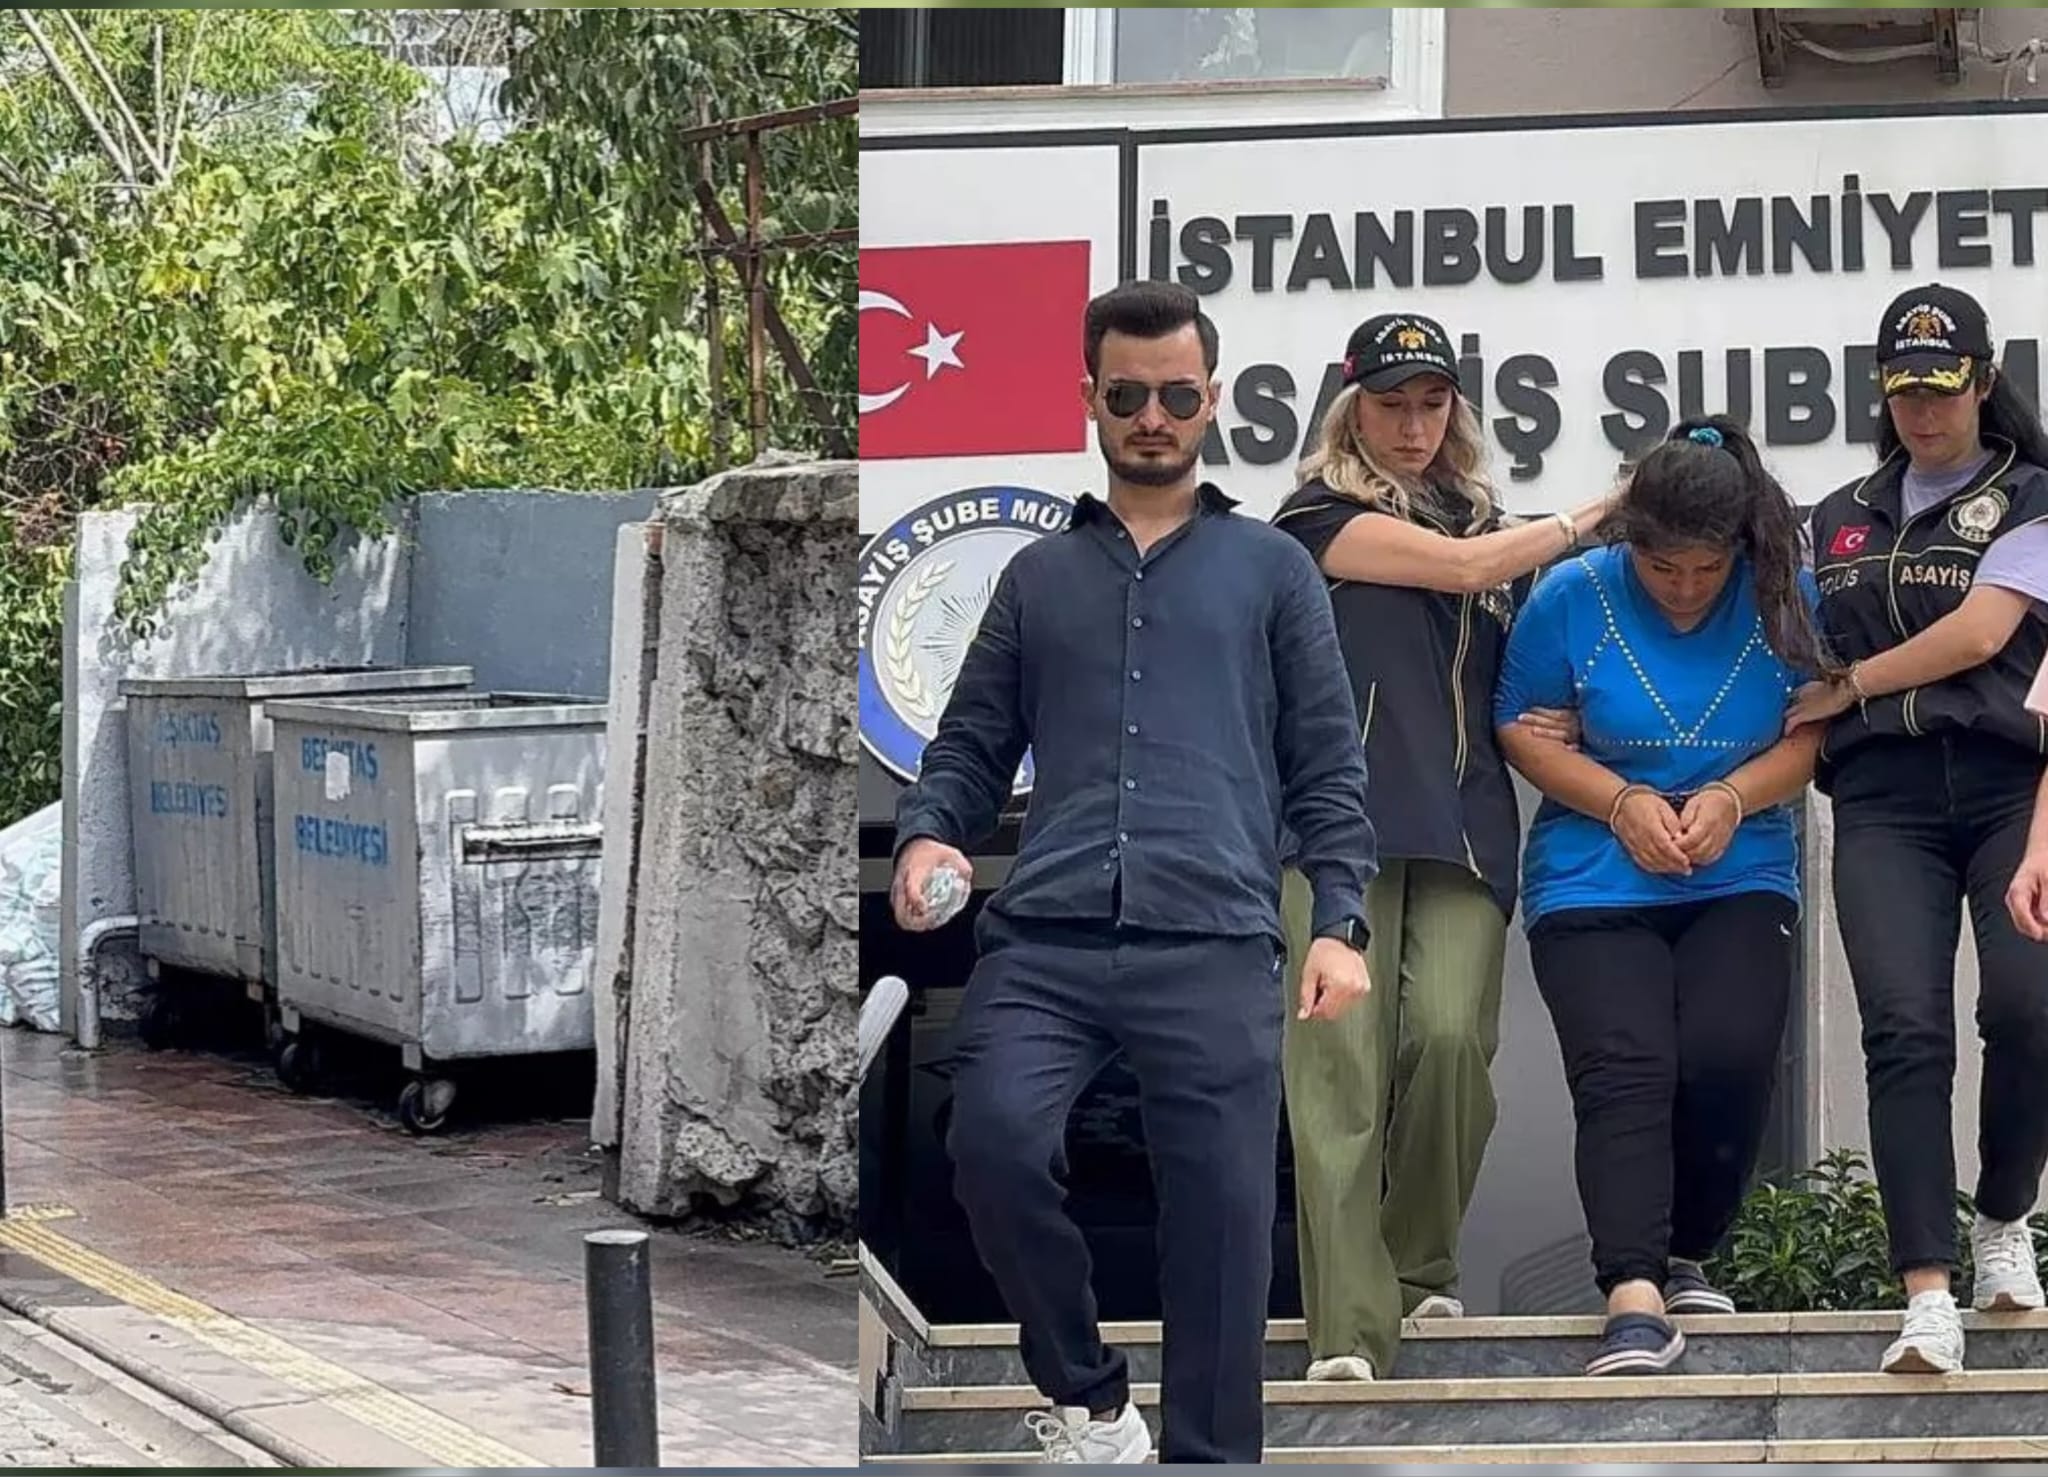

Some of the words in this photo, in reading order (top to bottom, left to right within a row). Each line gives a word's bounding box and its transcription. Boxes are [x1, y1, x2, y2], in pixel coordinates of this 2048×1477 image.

[1148, 199, 1603, 294] İSTANBUL
[1634, 173, 2048, 279] EMNİYET
[911, 497, 1000, 546] ŞUBE
[1900, 563, 1971, 593] ASAYİŞ
